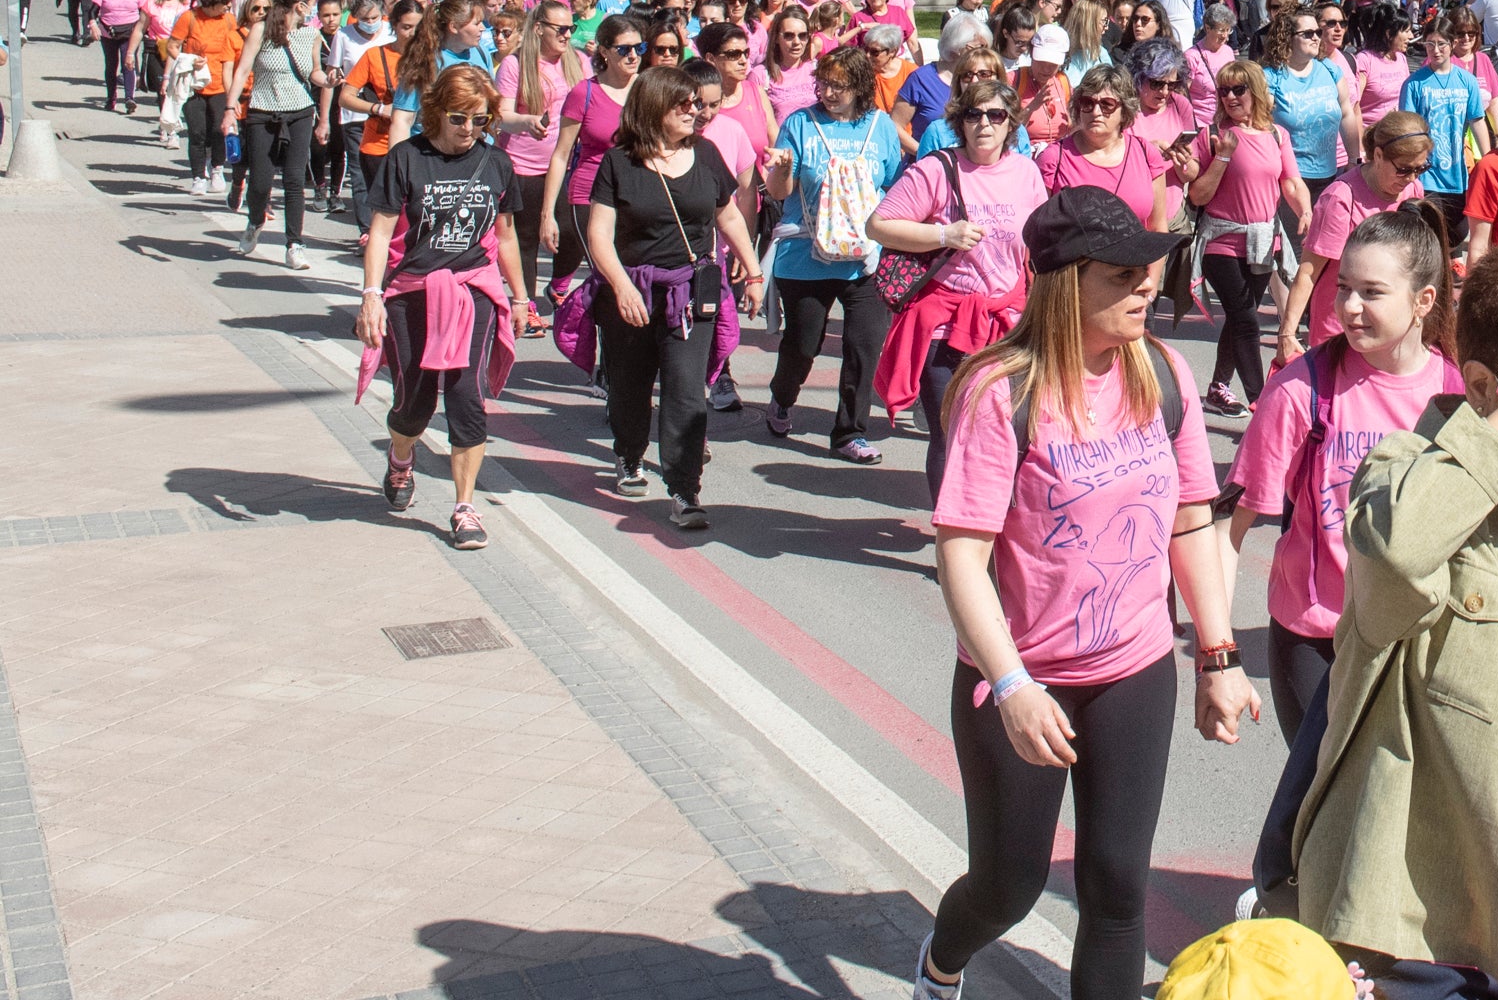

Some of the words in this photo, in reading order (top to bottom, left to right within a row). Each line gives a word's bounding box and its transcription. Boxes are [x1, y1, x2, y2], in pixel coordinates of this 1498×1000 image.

[1048, 439, 1116, 480] MARCHA
[1117, 418, 1168, 456] MUJERES
[1048, 451, 1170, 511] SEGOVIA
